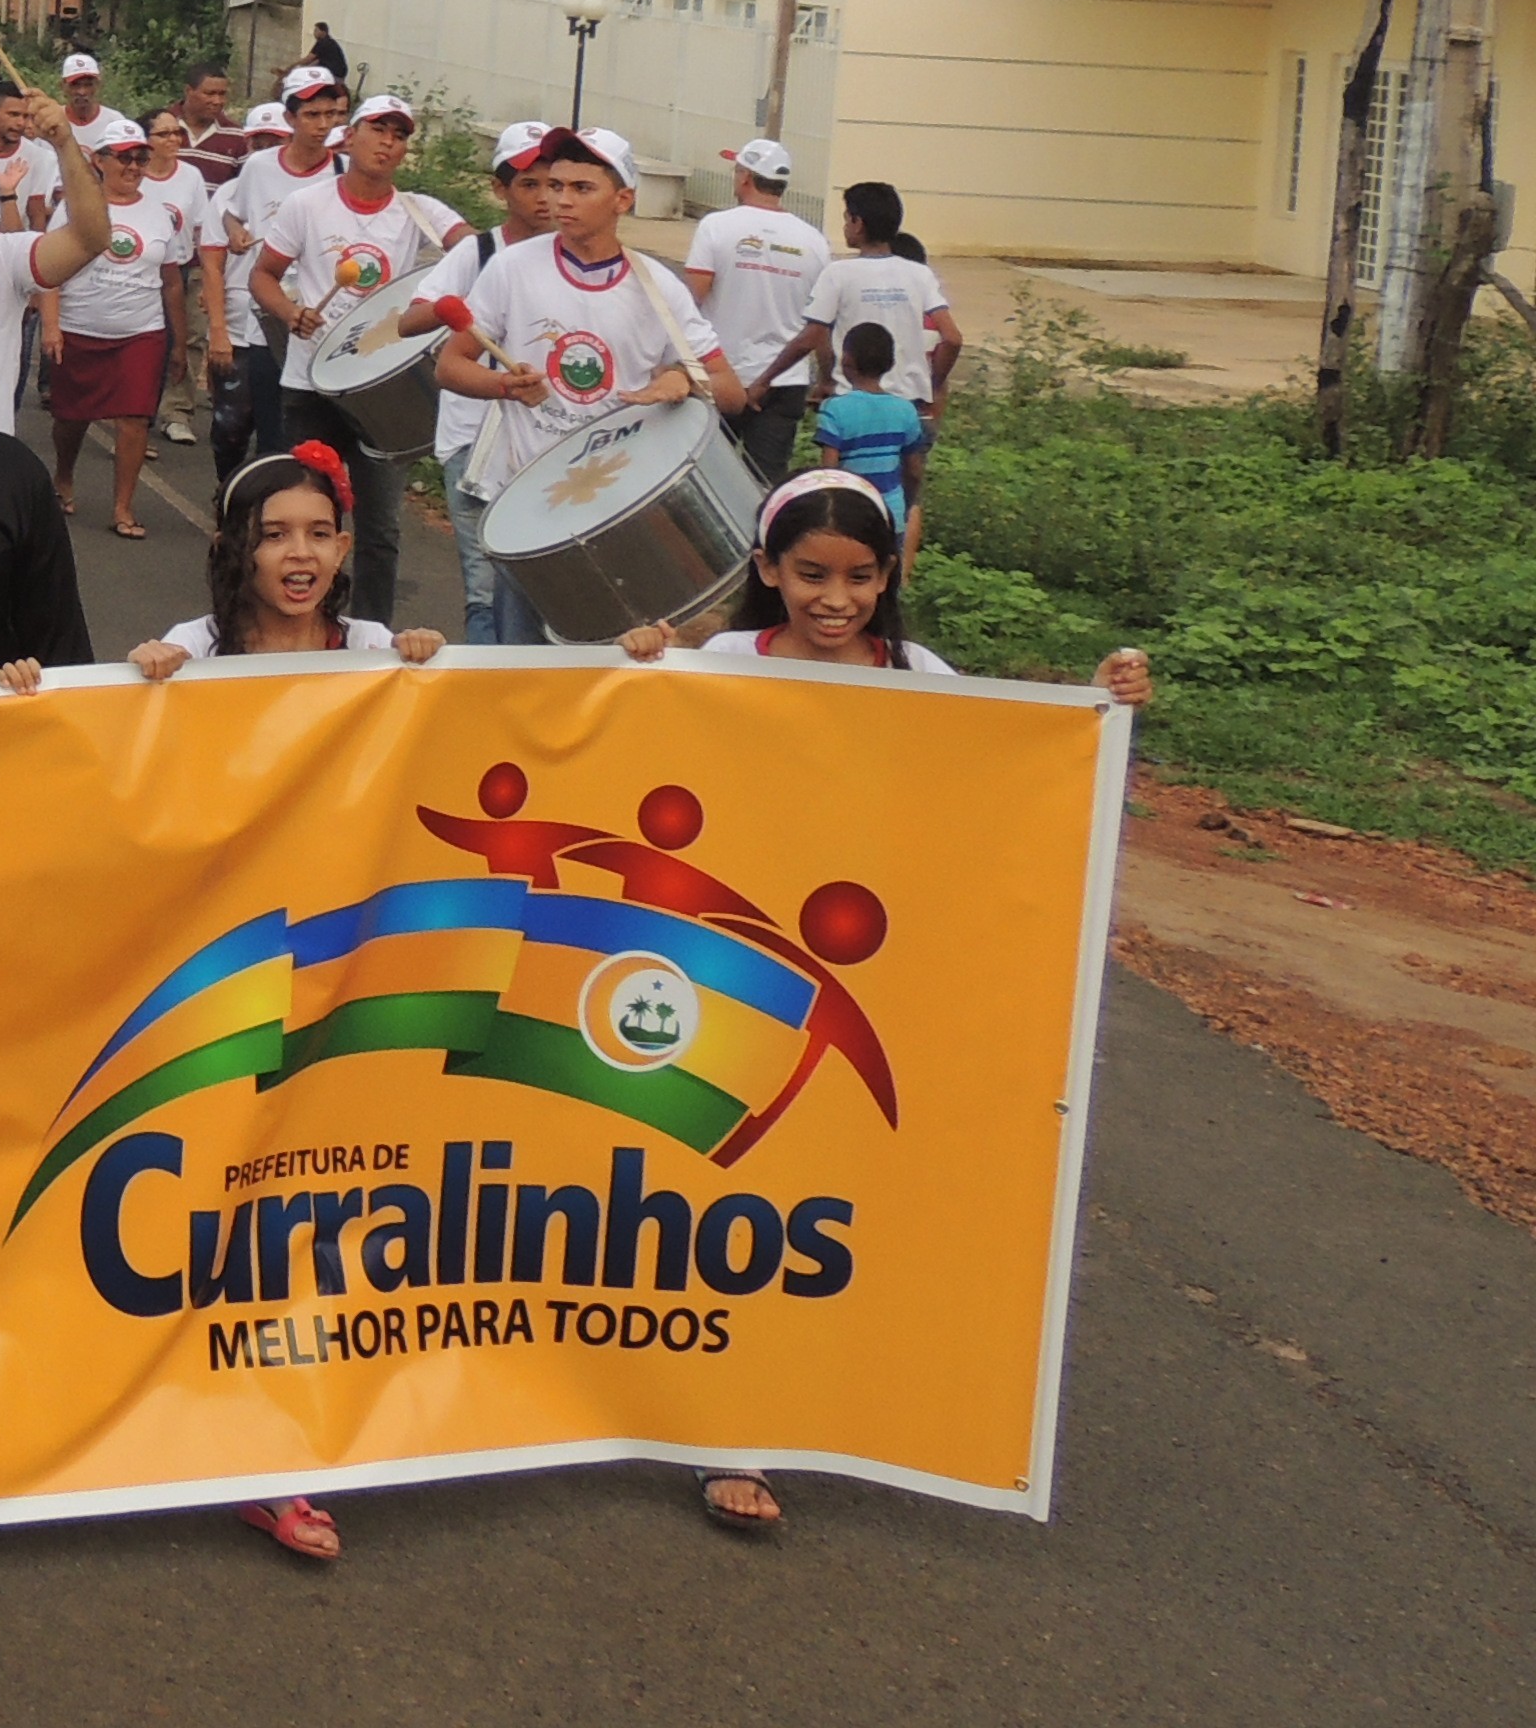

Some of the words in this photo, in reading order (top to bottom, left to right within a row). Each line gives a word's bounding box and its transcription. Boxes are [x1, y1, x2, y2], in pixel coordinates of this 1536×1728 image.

[225, 1144, 367, 1192] PREFEITURA
[372, 1144, 410, 1171] DE
[80, 1131, 854, 1318] Curralinhos
[208, 1308, 407, 1372] MELHOR
[417, 1299, 534, 1353] PARA
[545, 1300, 731, 1356] TODOS
